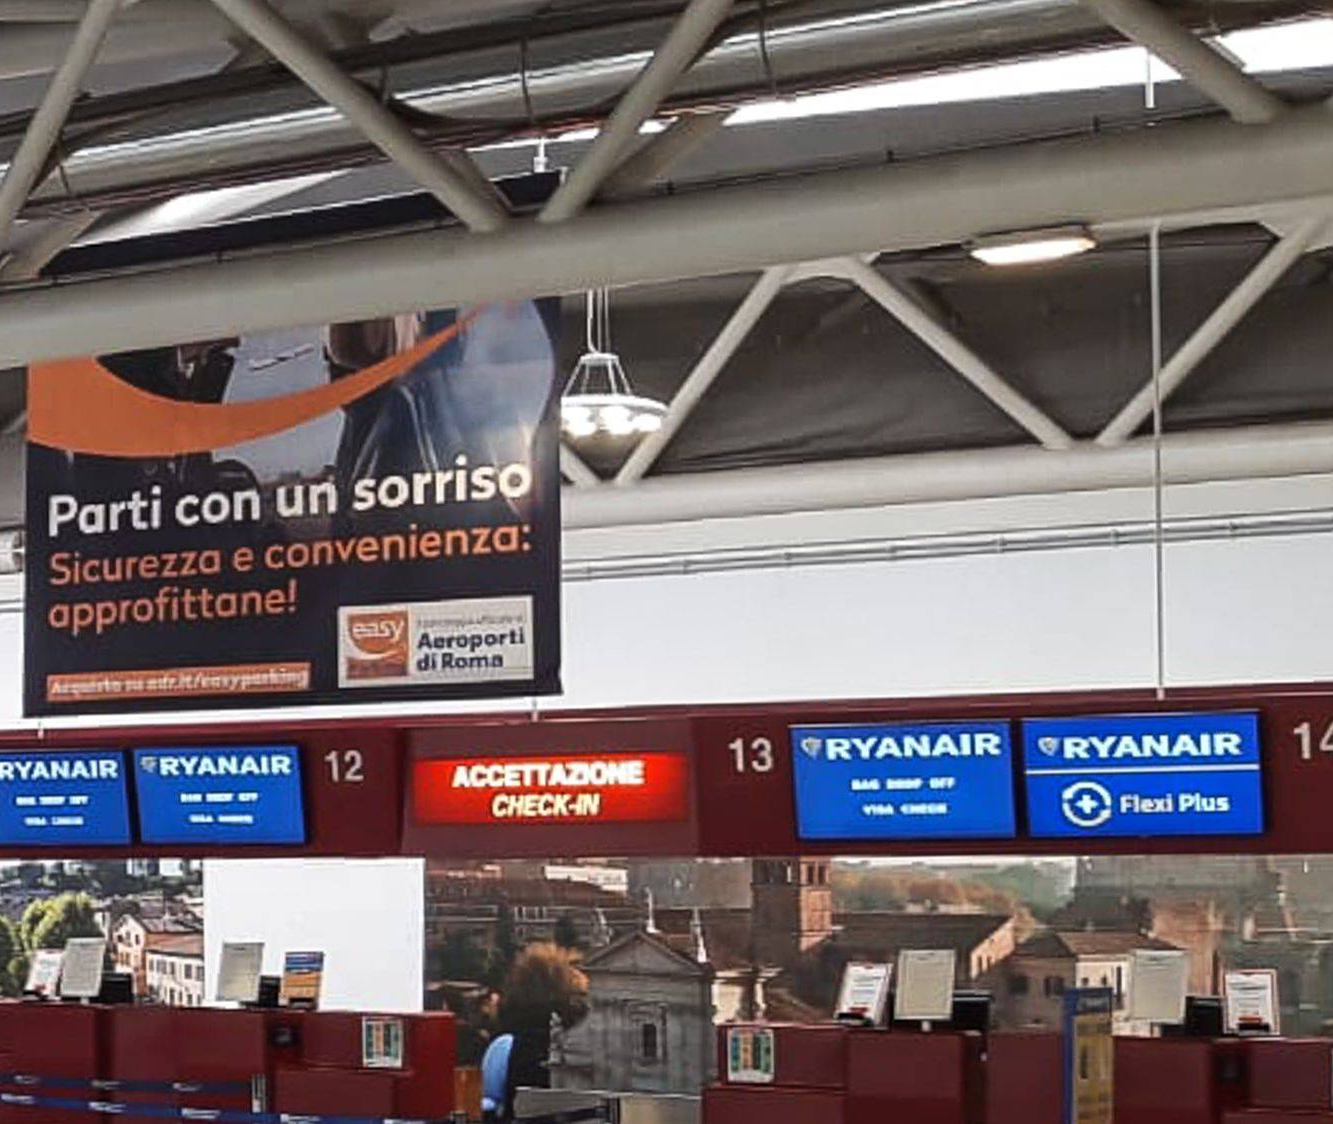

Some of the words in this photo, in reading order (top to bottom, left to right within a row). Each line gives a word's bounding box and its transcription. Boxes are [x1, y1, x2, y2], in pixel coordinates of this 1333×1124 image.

[47, 485, 162, 538] Parti
[175, 490, 261, 528] con
[276, 475, 336, 519] un
[352, 454, 531, 510] sorriso
[47, 545, 221, 586] Sicurezza
[233, 547, 252, 572] e
[264, 522, 532, 570] convenienza:
[47, 579, 298, 636] approfittane!
[416, 627, 526, 652] Aeroporti
[416, 653, 438, 672] di
[440, 653, 504, 670] Roma
[728, 737, 774, 772] 13
[824, 732, 1002, 761] RYANAIR
[1062, 732, 1243, 759] RYANAIR
[158, 754, 292, 776] RYANAIR
[324, 749, 365, 783] 12
[451, 759, 646, 788] ACCETTAZIONE
[491, 793, 601, 817] CHECK-IN
[1119, 793, 1173, 814] Flexi
[1178, 792, 1230, 813] Plus
